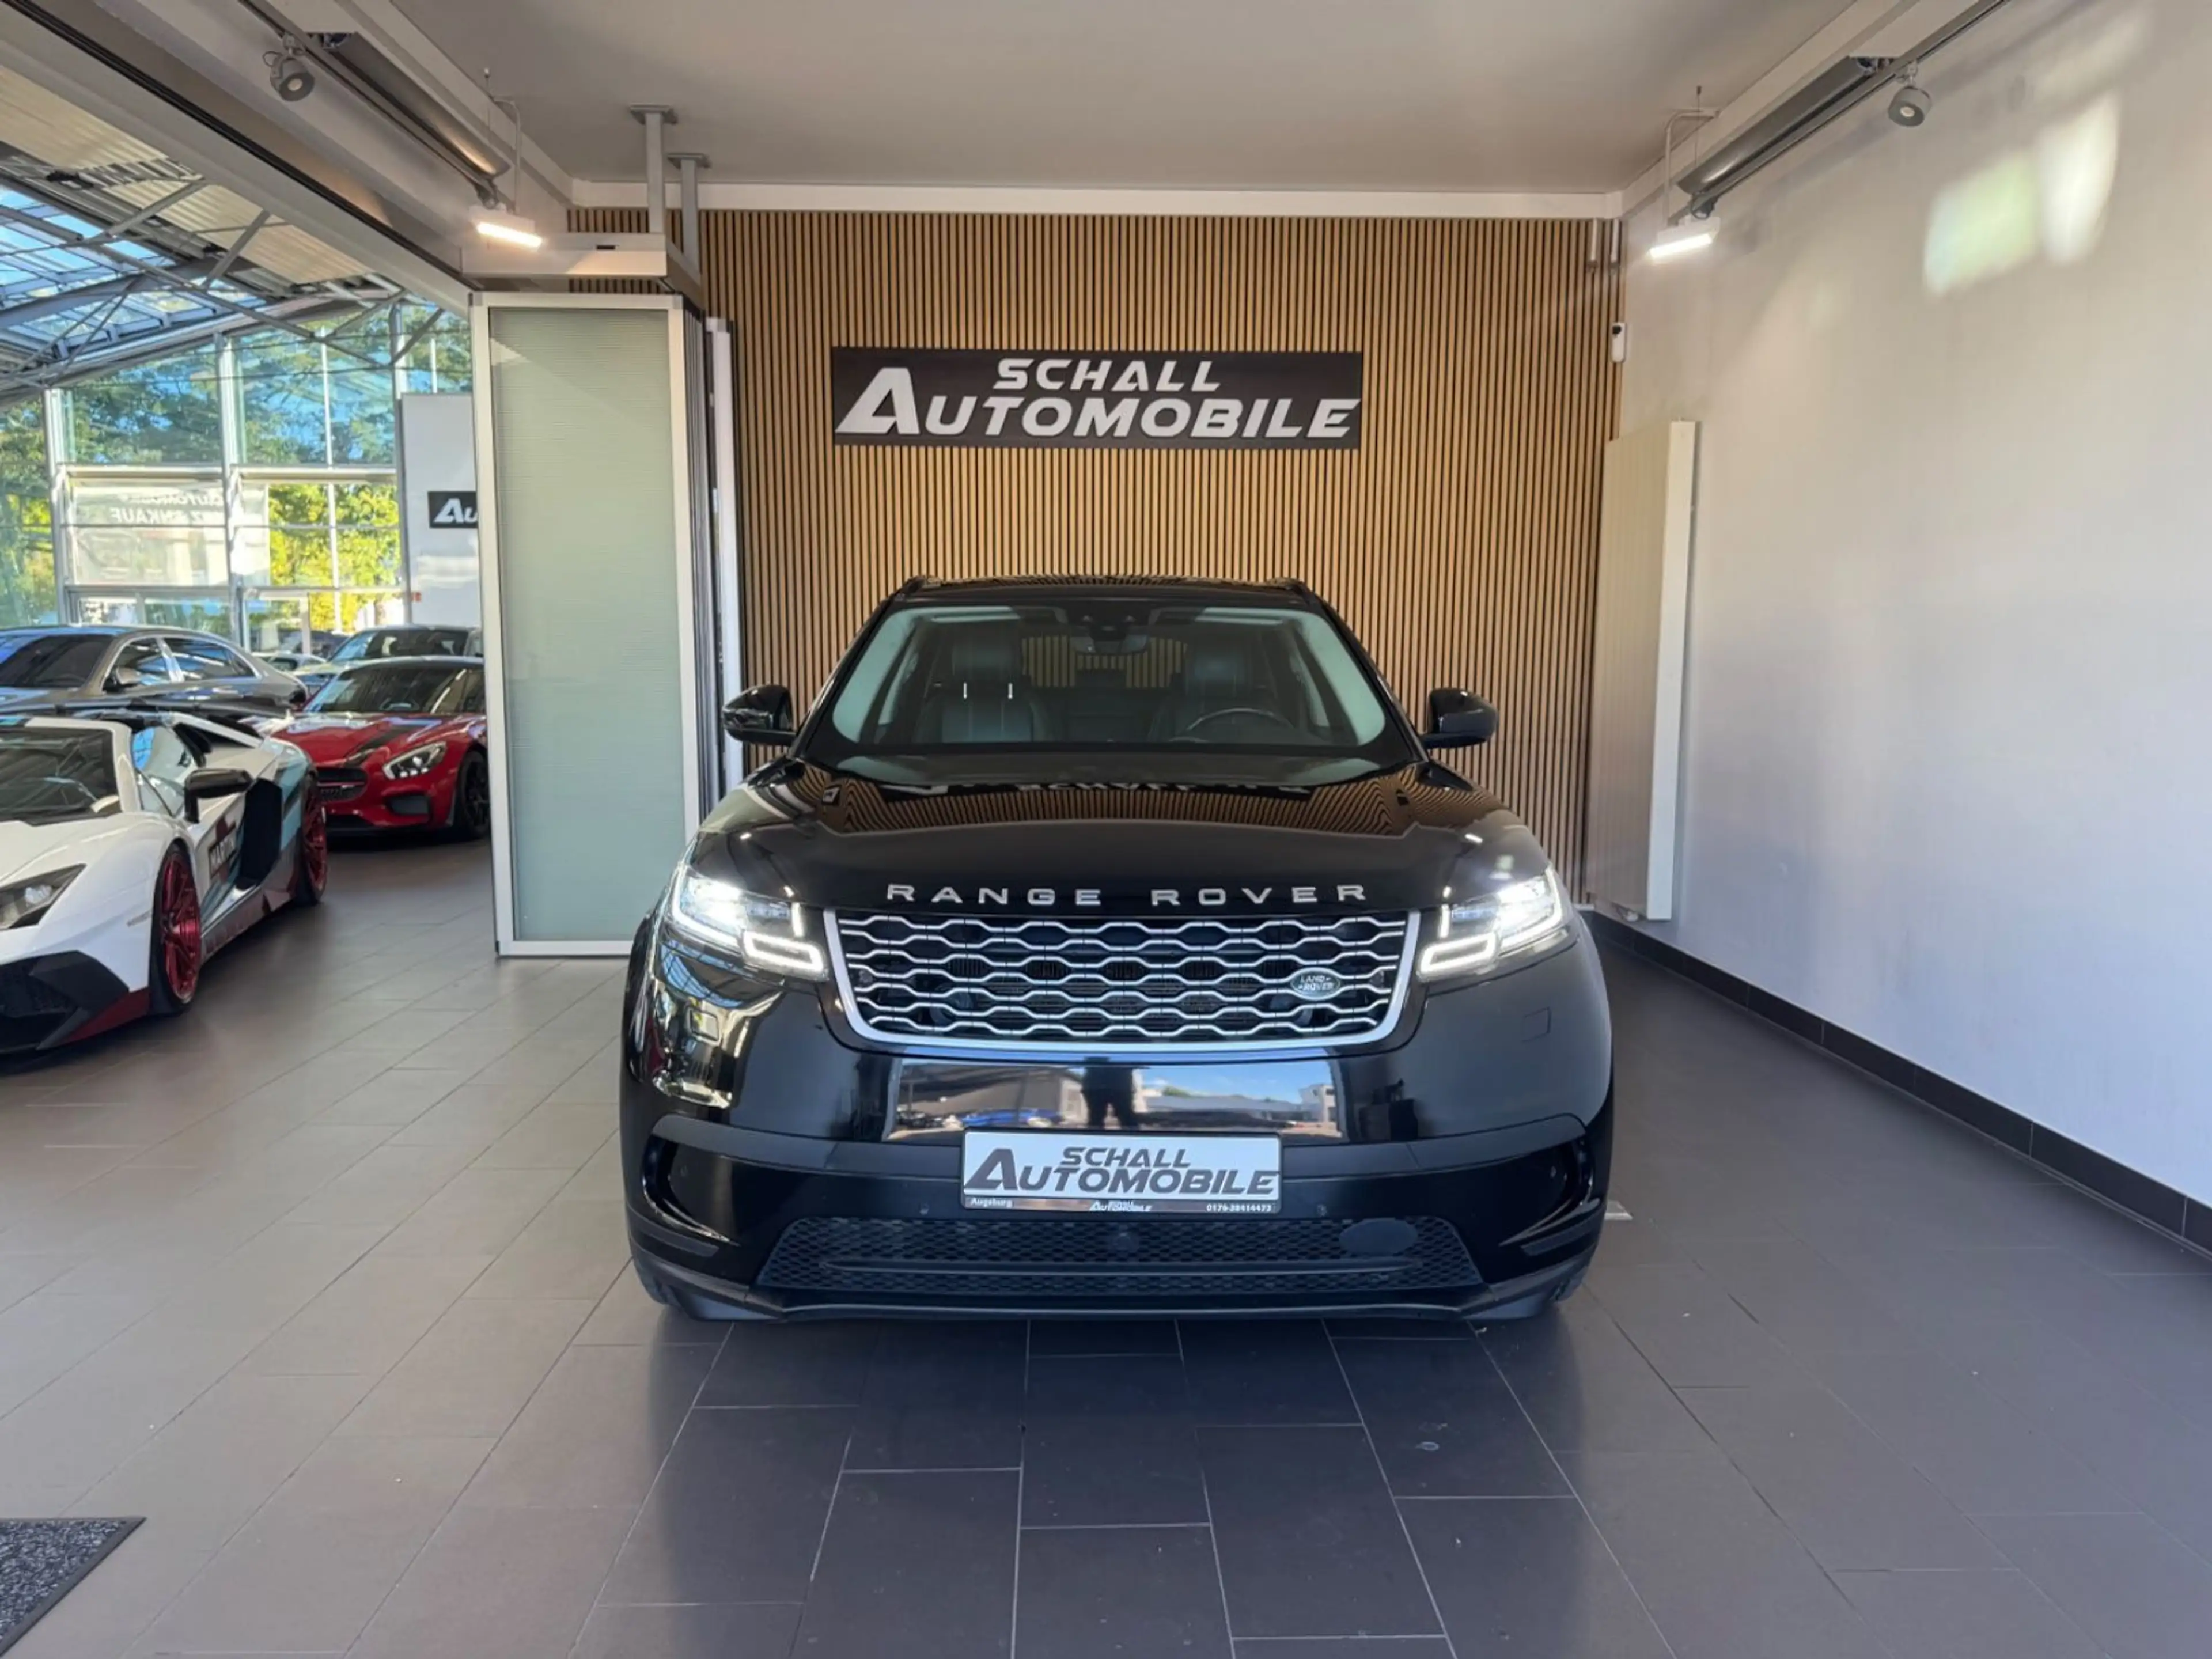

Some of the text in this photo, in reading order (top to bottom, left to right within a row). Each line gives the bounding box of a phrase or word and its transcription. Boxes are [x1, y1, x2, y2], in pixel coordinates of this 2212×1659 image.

[992, 357, 1220, 392] SCHALL
[835, 366, 1360, 438] AUTOMOBILE
[887, 883, 1366, 906] RANGE ROVER
[1300, 974, 1325, 983] LAND
[1303, 982, 1334, 991] ROVER
[1060, 1146, 1191, 1168] SCHALL
[964, 1148, 1280, 1195] AUTOMOBILE
